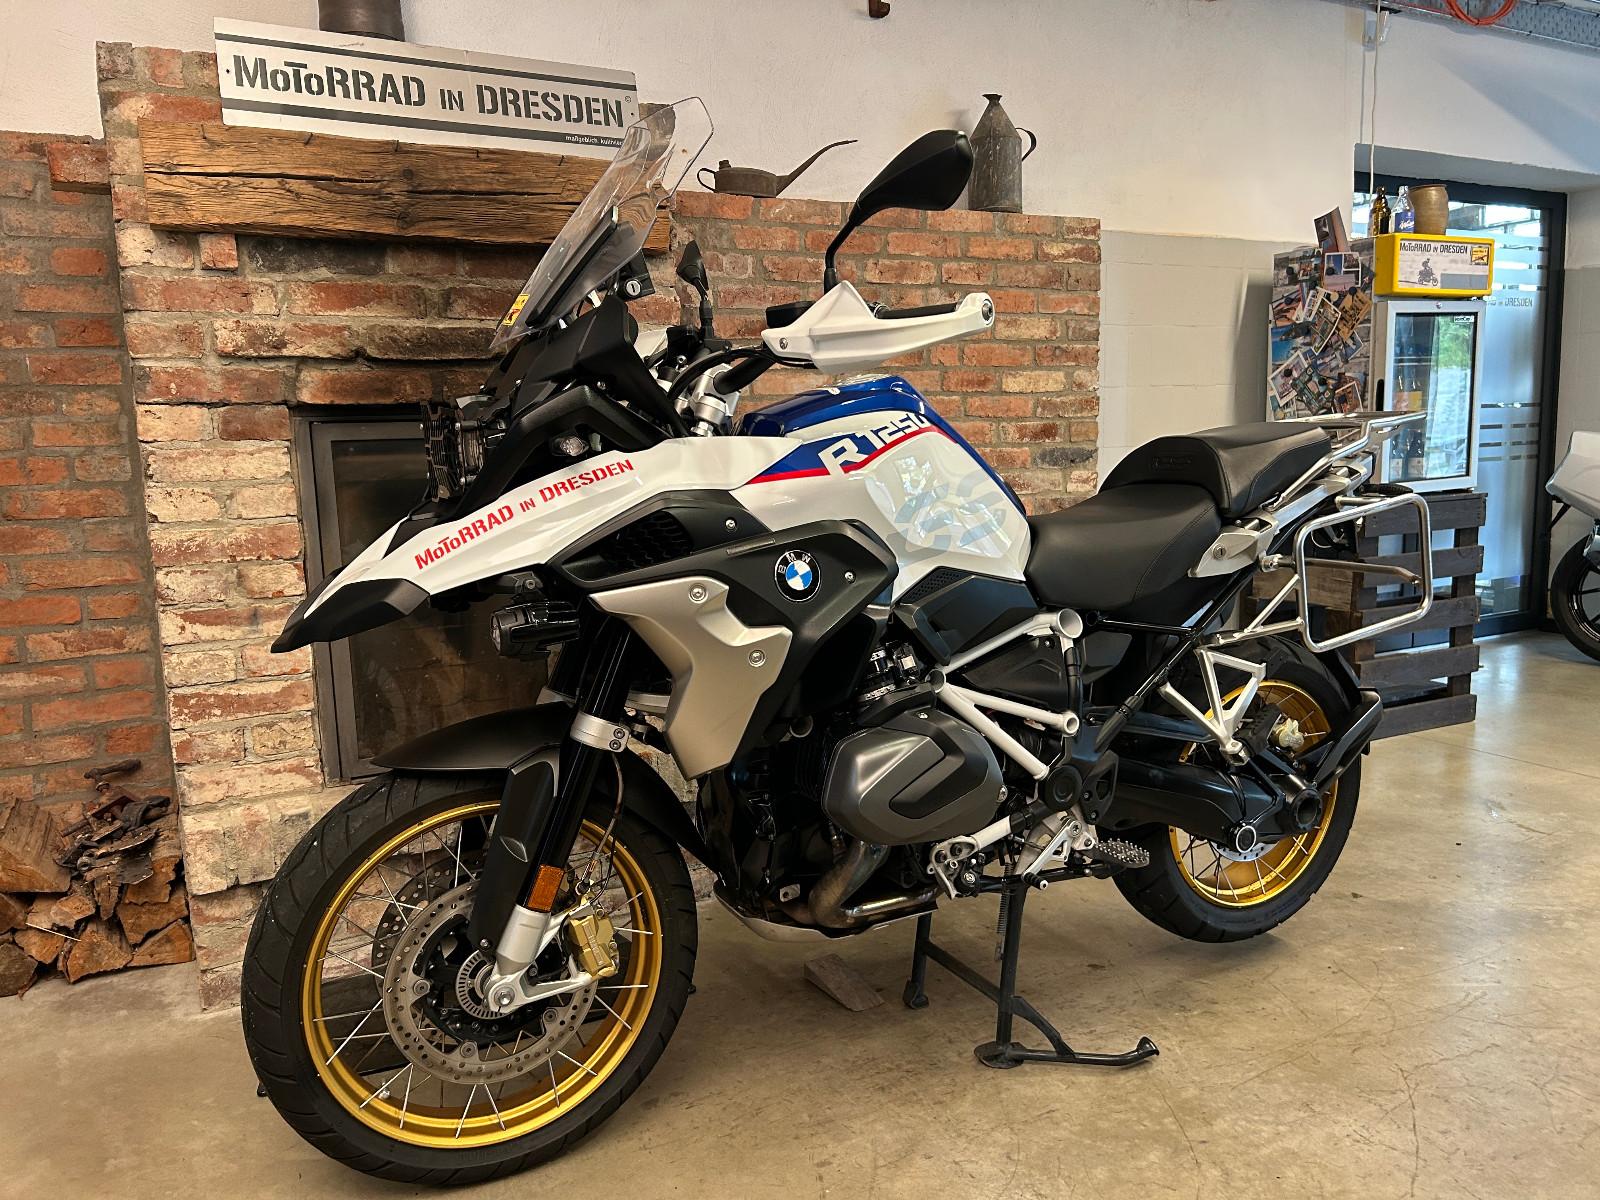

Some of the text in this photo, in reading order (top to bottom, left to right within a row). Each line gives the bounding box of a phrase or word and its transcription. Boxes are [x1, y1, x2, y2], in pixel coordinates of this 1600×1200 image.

[439, 88, 465, 112] IN
[476, 84, 624, 128] DRESDEN
[1440, 244, 1468, 254] DRESDEN
[519, 498, 537, 513] IN
[539, 459, 634, 503] DRESDEN
